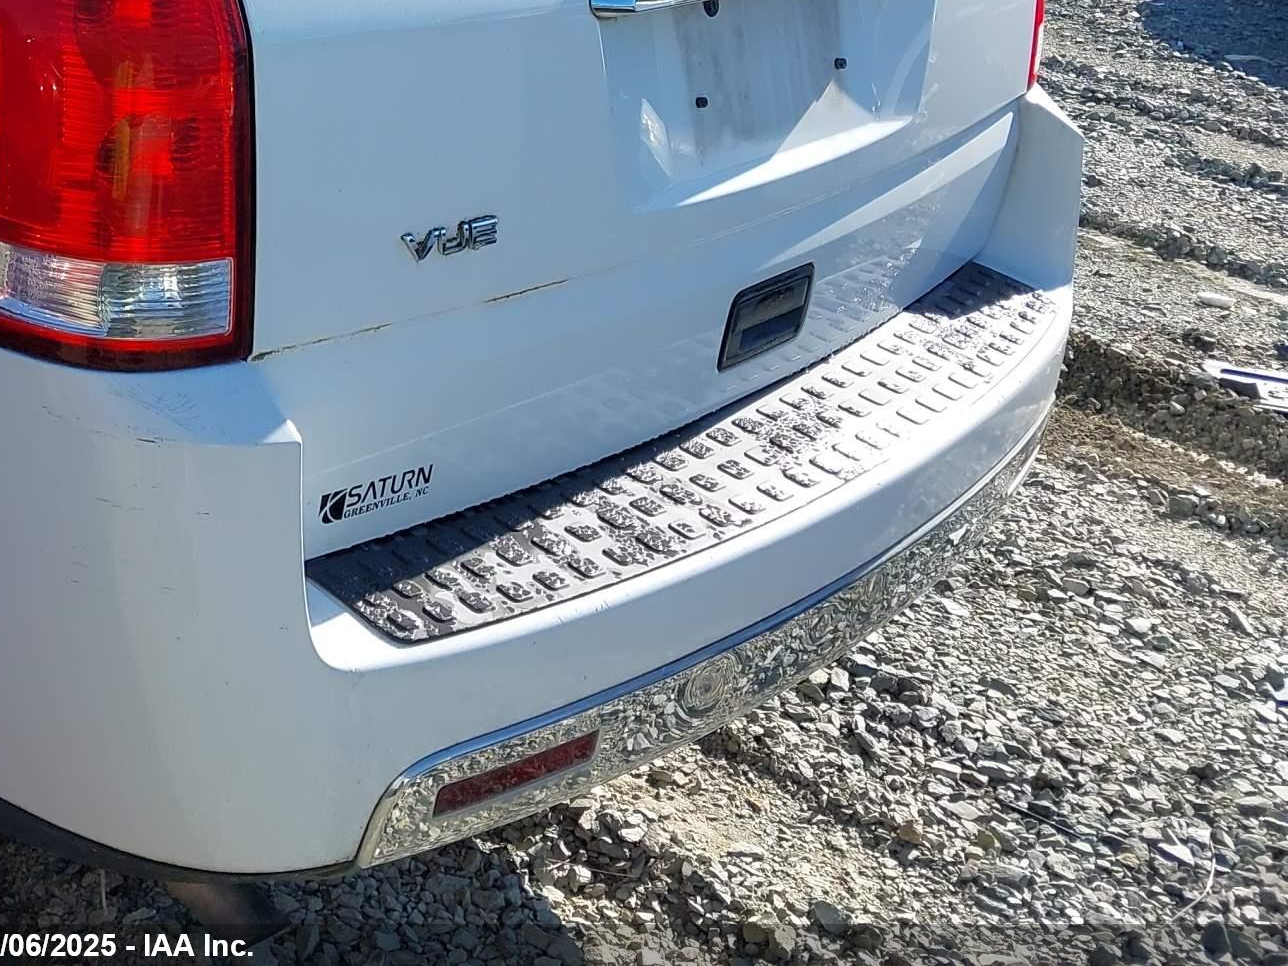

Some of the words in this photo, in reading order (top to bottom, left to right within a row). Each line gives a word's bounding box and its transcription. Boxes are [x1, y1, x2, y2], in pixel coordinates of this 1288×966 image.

[400, 214, 498, 263] VUE
[343, 491, 412, 519] GREENVILLE,
[415, 486, 430, 498] NC
[346, 463, 434, 508] SATURN
